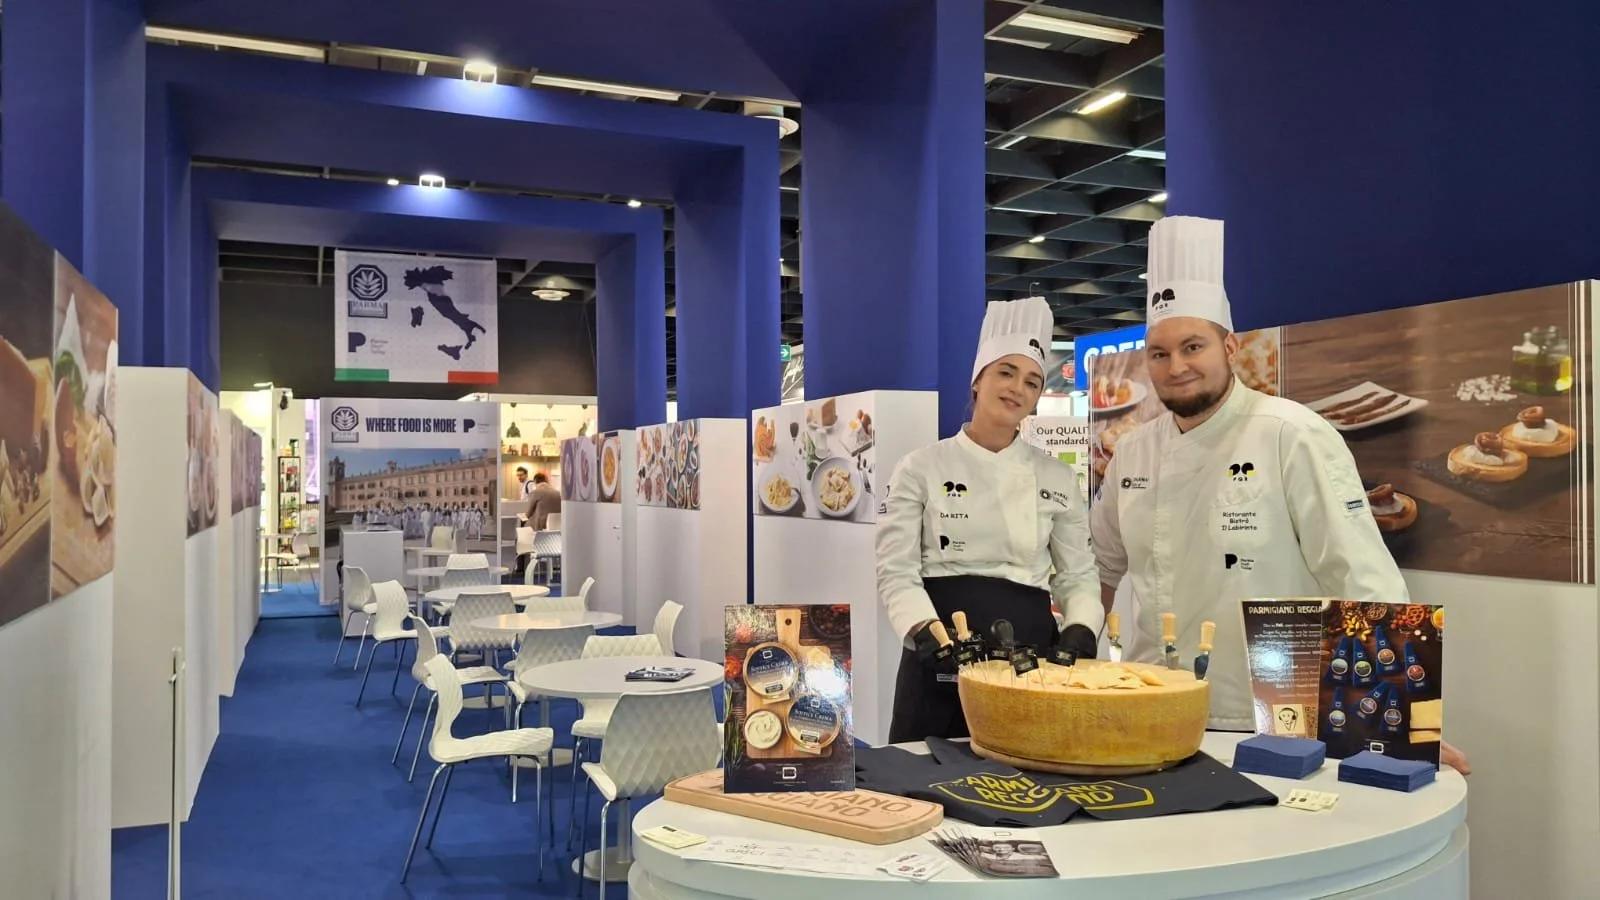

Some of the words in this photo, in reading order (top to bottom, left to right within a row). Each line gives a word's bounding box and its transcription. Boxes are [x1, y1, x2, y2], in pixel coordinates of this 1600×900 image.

[366, 417, 396, 432] WHERE
[398, 418, 420, 432] FOOD
[422, 418, 432, 432] IS
[433, 418, 456, 433] MORE
[1036, 427, 1054, 435] Our
[1046, 437, 1088, 445] standards
[1248, 606, 1295, 614] PARMIGIANO
